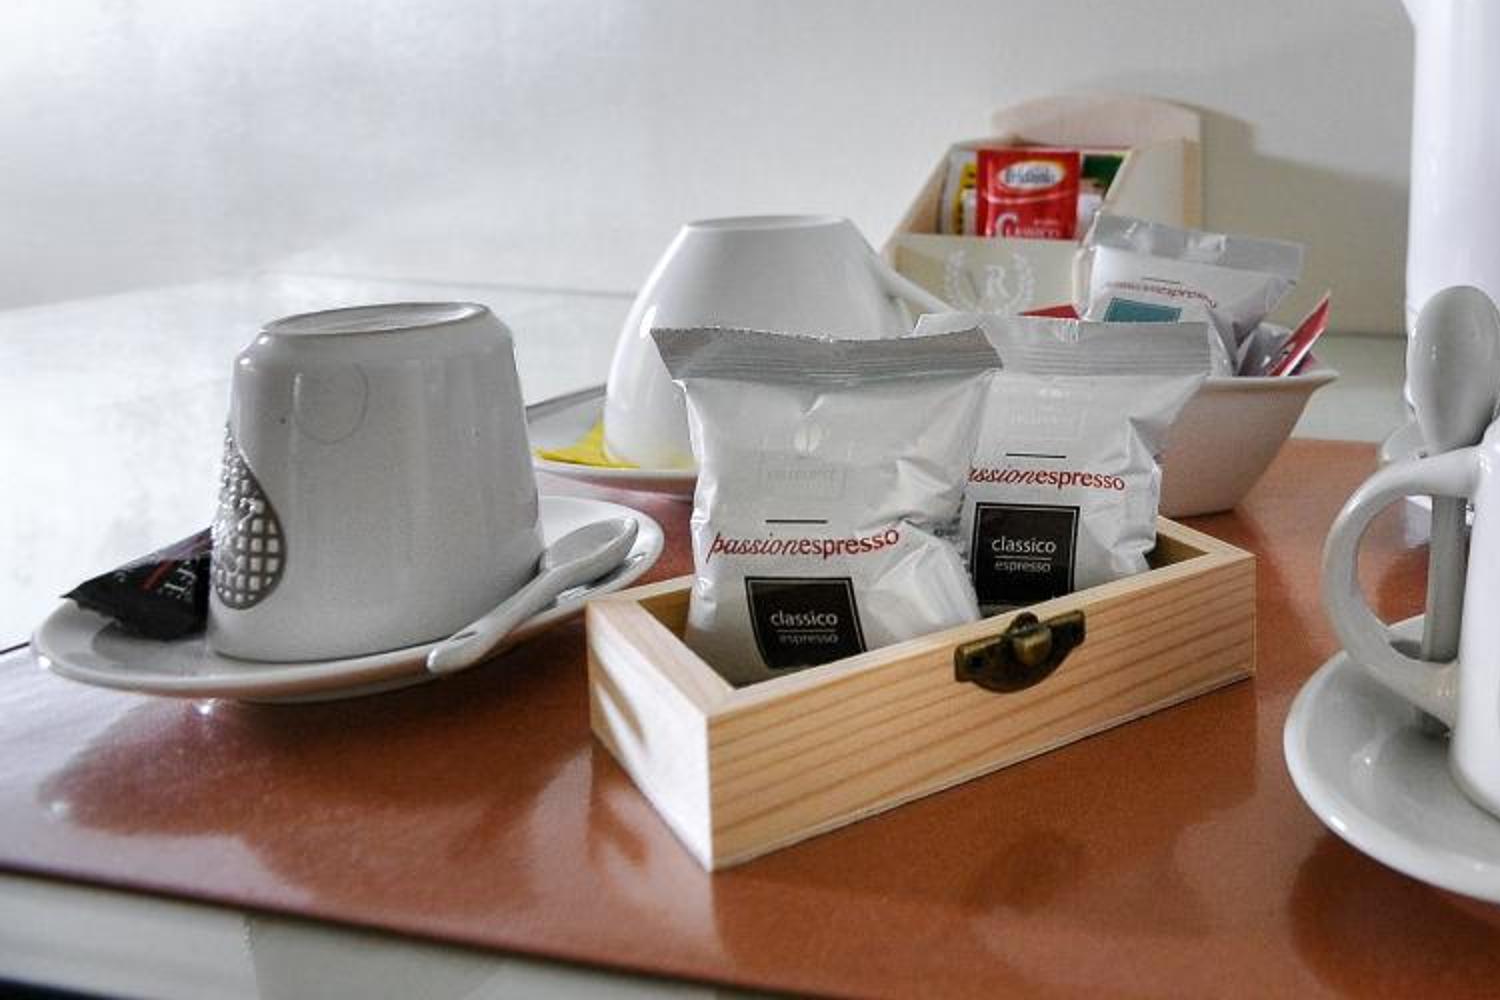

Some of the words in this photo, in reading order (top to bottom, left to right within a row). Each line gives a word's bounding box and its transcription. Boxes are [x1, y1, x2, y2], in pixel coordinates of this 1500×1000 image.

[706, 529, 900, 563] passionespresso
[992, 536, 1056, 553] classico
[994, 560, 1052, 573] espresso
[770, 610, 838, 627] classico
[779, 633, 838, 645] espresso
